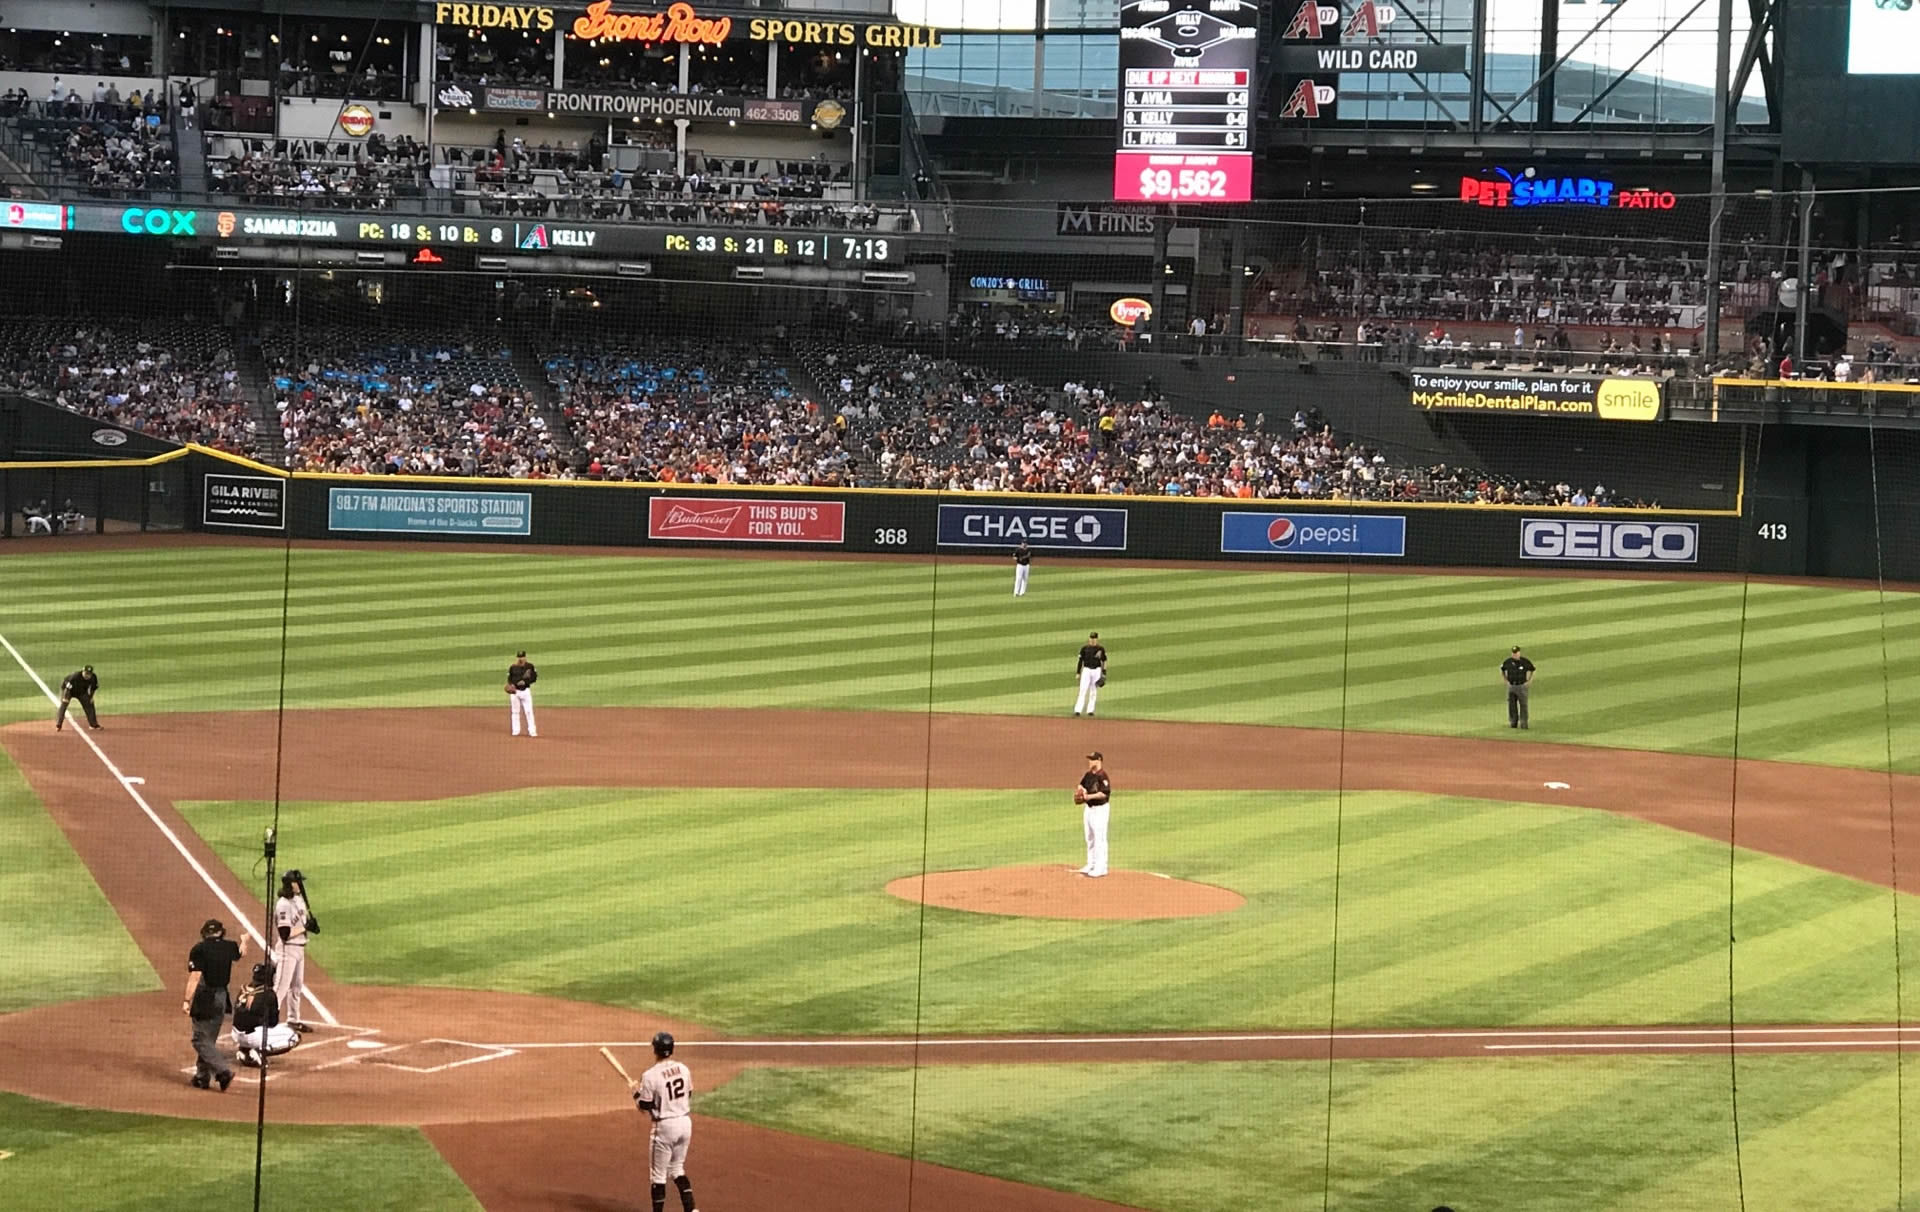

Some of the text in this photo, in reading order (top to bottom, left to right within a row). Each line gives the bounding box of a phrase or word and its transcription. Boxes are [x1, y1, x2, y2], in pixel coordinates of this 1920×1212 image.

[436, 0, 942, 48] FRIDAY'S Front Row SPORTS GRILL
[1320, 9, 1335, 22] 07
[1379, 9, 1391, 21] 11
[1317, 50, 1417, 69] WILD CARD
[487, 94, 541, 109] twitter
[547, 92, 741, 117] FRONTROWPHOENIX.com
[1140, 91, 1173, 105] AVILA
[1318, 89, 1330, 102] 17
[746, 107, 800, 121] 462-3506
[1140, 111, 1174, 125] KELLY
[1126, 131, 1137, 144] 1.
[1225, 132, 1245, 145] 0-1
[1140, 167, 1227, 199] $9,562
[1619, 191, 1676, 209] PATIO
[122, 207, 196, 235] COX
[1099, 215, 1155, 233] FITNES
[359, 222, 503, 243] PC: 18 S: 10 B: 8
[552, 229, 596, 246] KELLY
[666, 234, 815, 256] PC: 33 S: 21 B: 12
[842, 238, 889, 260] 7:13
[1018, 278, 1045, 291] GRILL
[1412, 374, 1594, 394] To enjoy your smile, plan for it.
[1412, 391, 1593, 413] MySmileDentalPlan.com
[1604, 390, 1654, 409] smile
[211, 485, 278, 500] GILA RIVER
[336, 495, 524, 515] 98.7 FM ARIZONA'S SPORTS STATION
[749, 506, 818, 521] THIS BUD'S
[669, 505, 732, 525] Budweiser
[749, 521, 805, 536] FOR YOU.
[963, 514, 1069, 539] CHASE
[1300, 524, 1358, 546] pepsi
[1758, 523, 1788, 541] 413
[874, 528, 908, 545] 368
[1524, 521, 1695, 560] GEICO
[665, 1077, 685, 1101] 12
